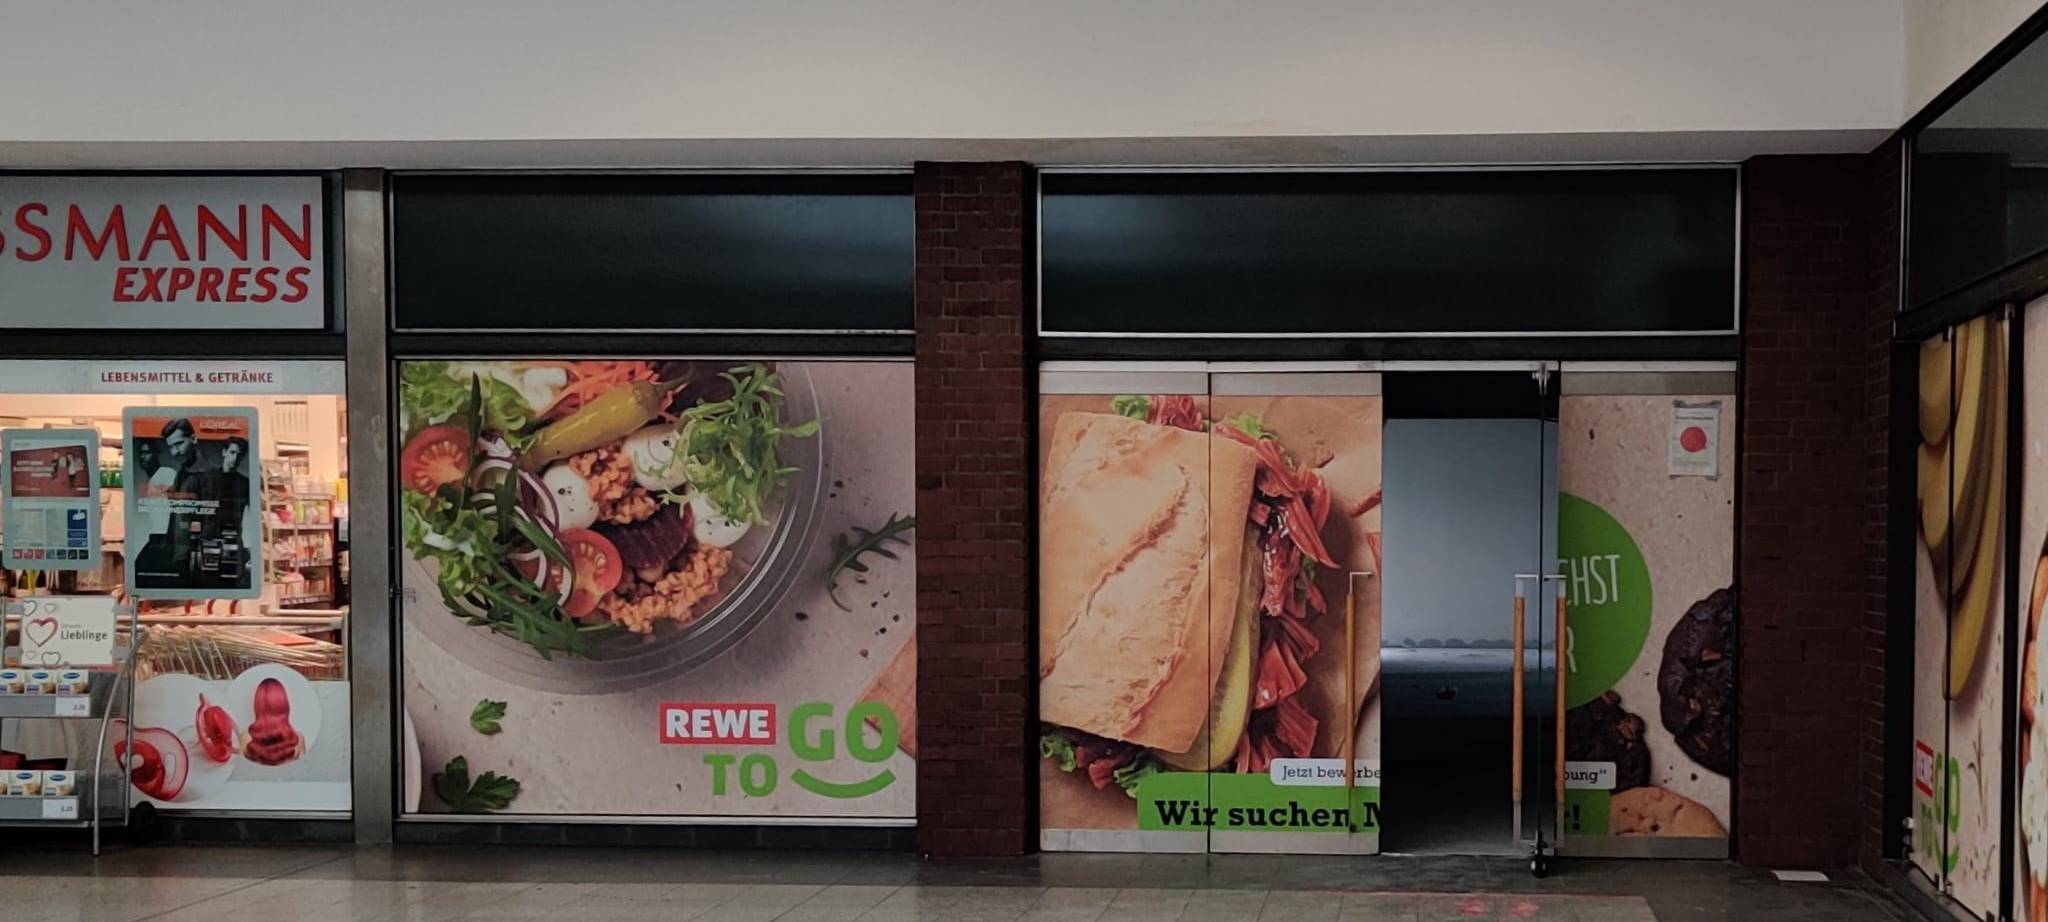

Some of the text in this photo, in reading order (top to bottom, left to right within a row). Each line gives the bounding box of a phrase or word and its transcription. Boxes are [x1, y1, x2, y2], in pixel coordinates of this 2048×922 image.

[0, 203, 311, 260] SMANN
[112, 267, 312, 303] EXPRESS
[101, 369, 274, 383] LEBENSMITTEL & GETRÄNKE
[60, 630, 108, 642] Lieblinge
[666, 708, 770, 739] REWE
[788, 701, 899, 763] GO
[703, 753, 778, 797] TO
[1281, 765, 1313, 780] Jetzt
[1154, 800, 1218, 827] Wir
[1229, 801, 1350, 827] suchen
